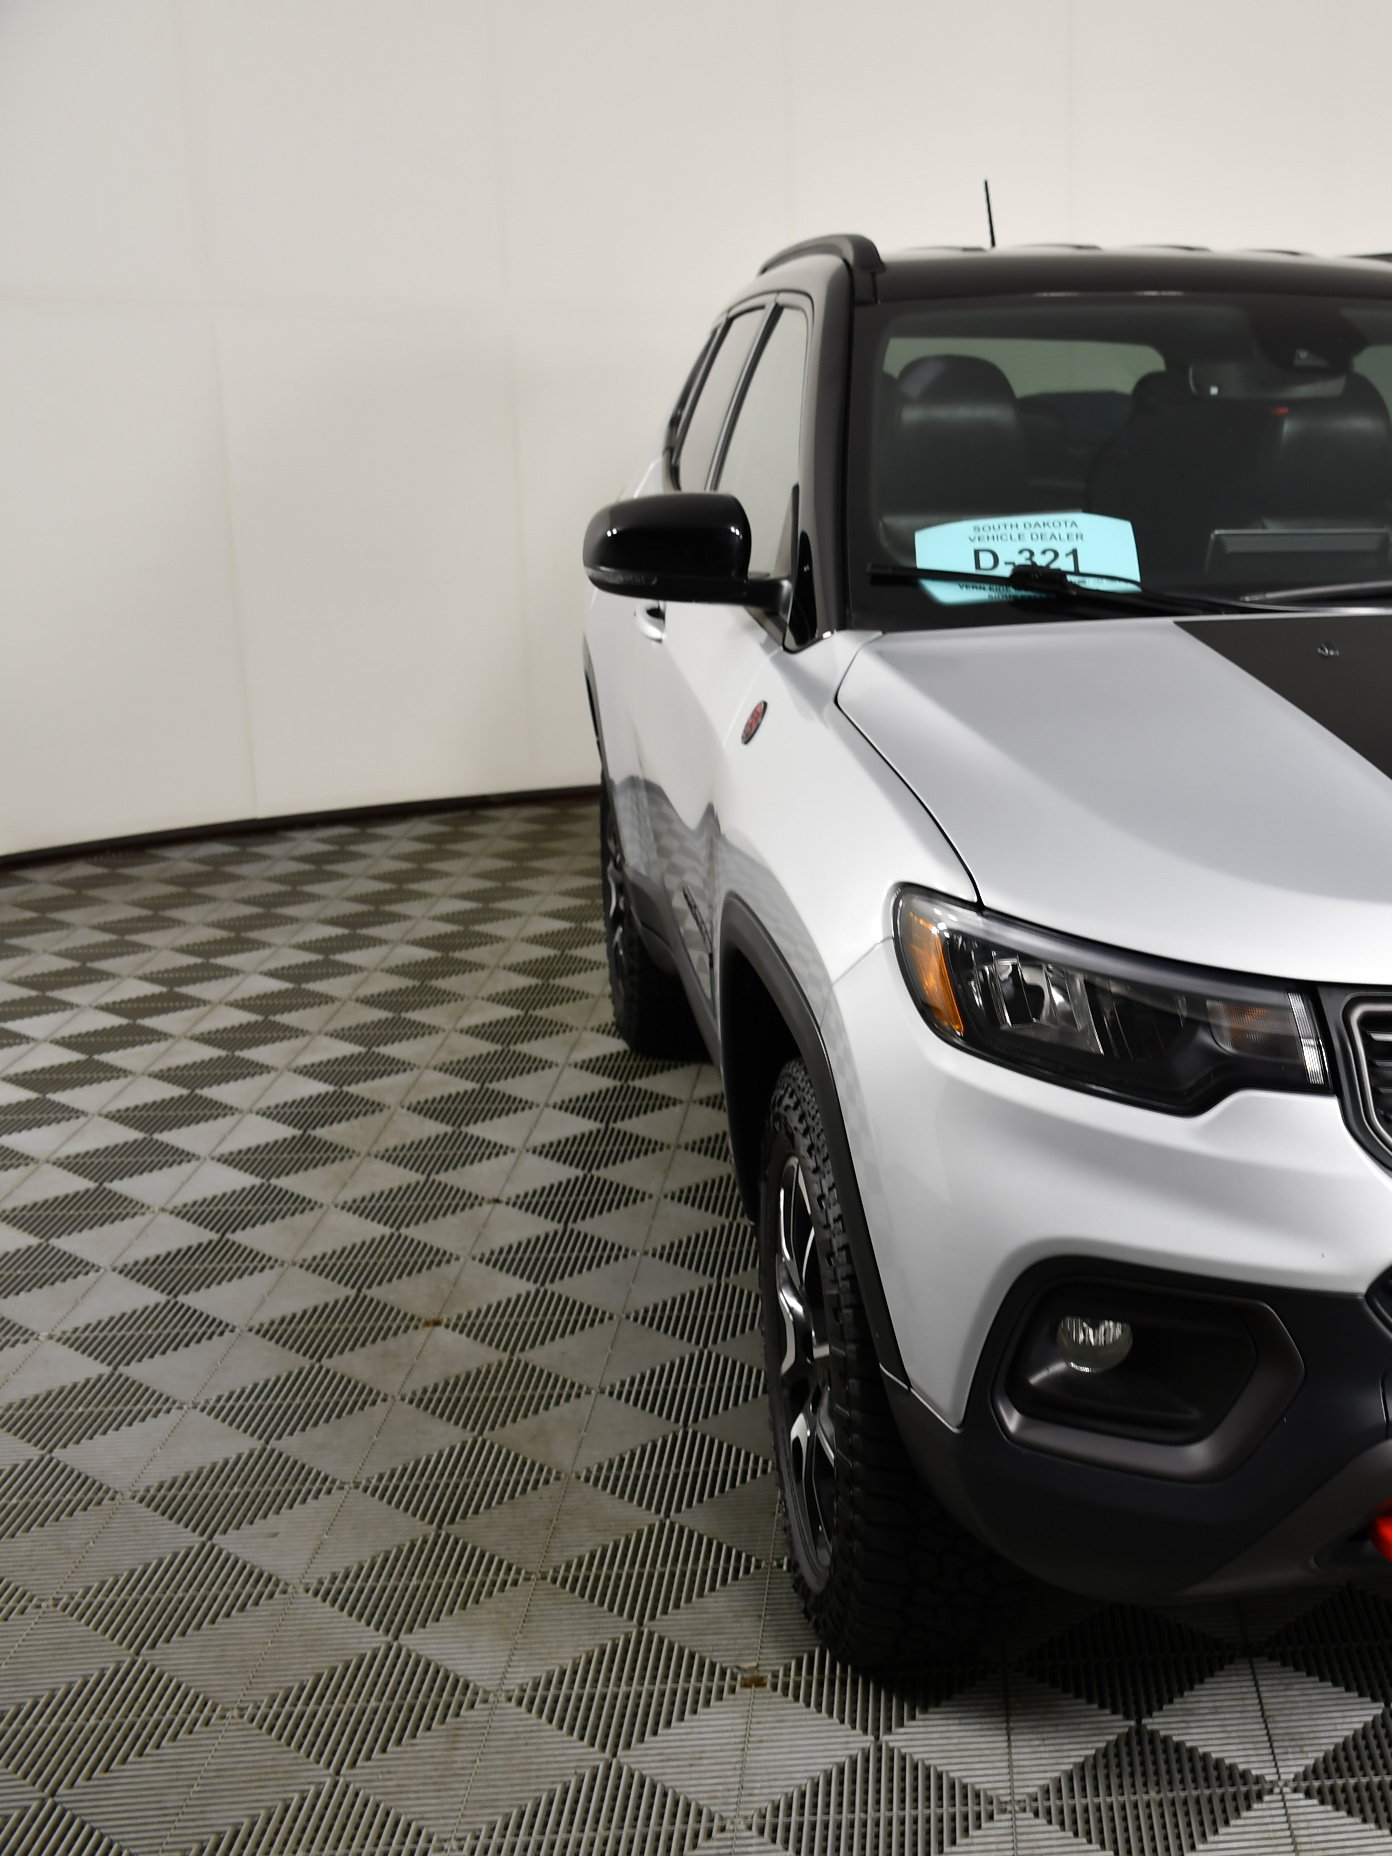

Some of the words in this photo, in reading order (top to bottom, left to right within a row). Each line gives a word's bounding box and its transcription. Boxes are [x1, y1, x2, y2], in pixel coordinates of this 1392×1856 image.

[973, 522, 1018, 532] SOUTH
[1023, 520, 1078, 530] DAKOTA
[968, 533, 1026, 543] VEHICLE
[1030, 532, 1084, 542] DEALER
[973, 548, 1080, 573] D-321
